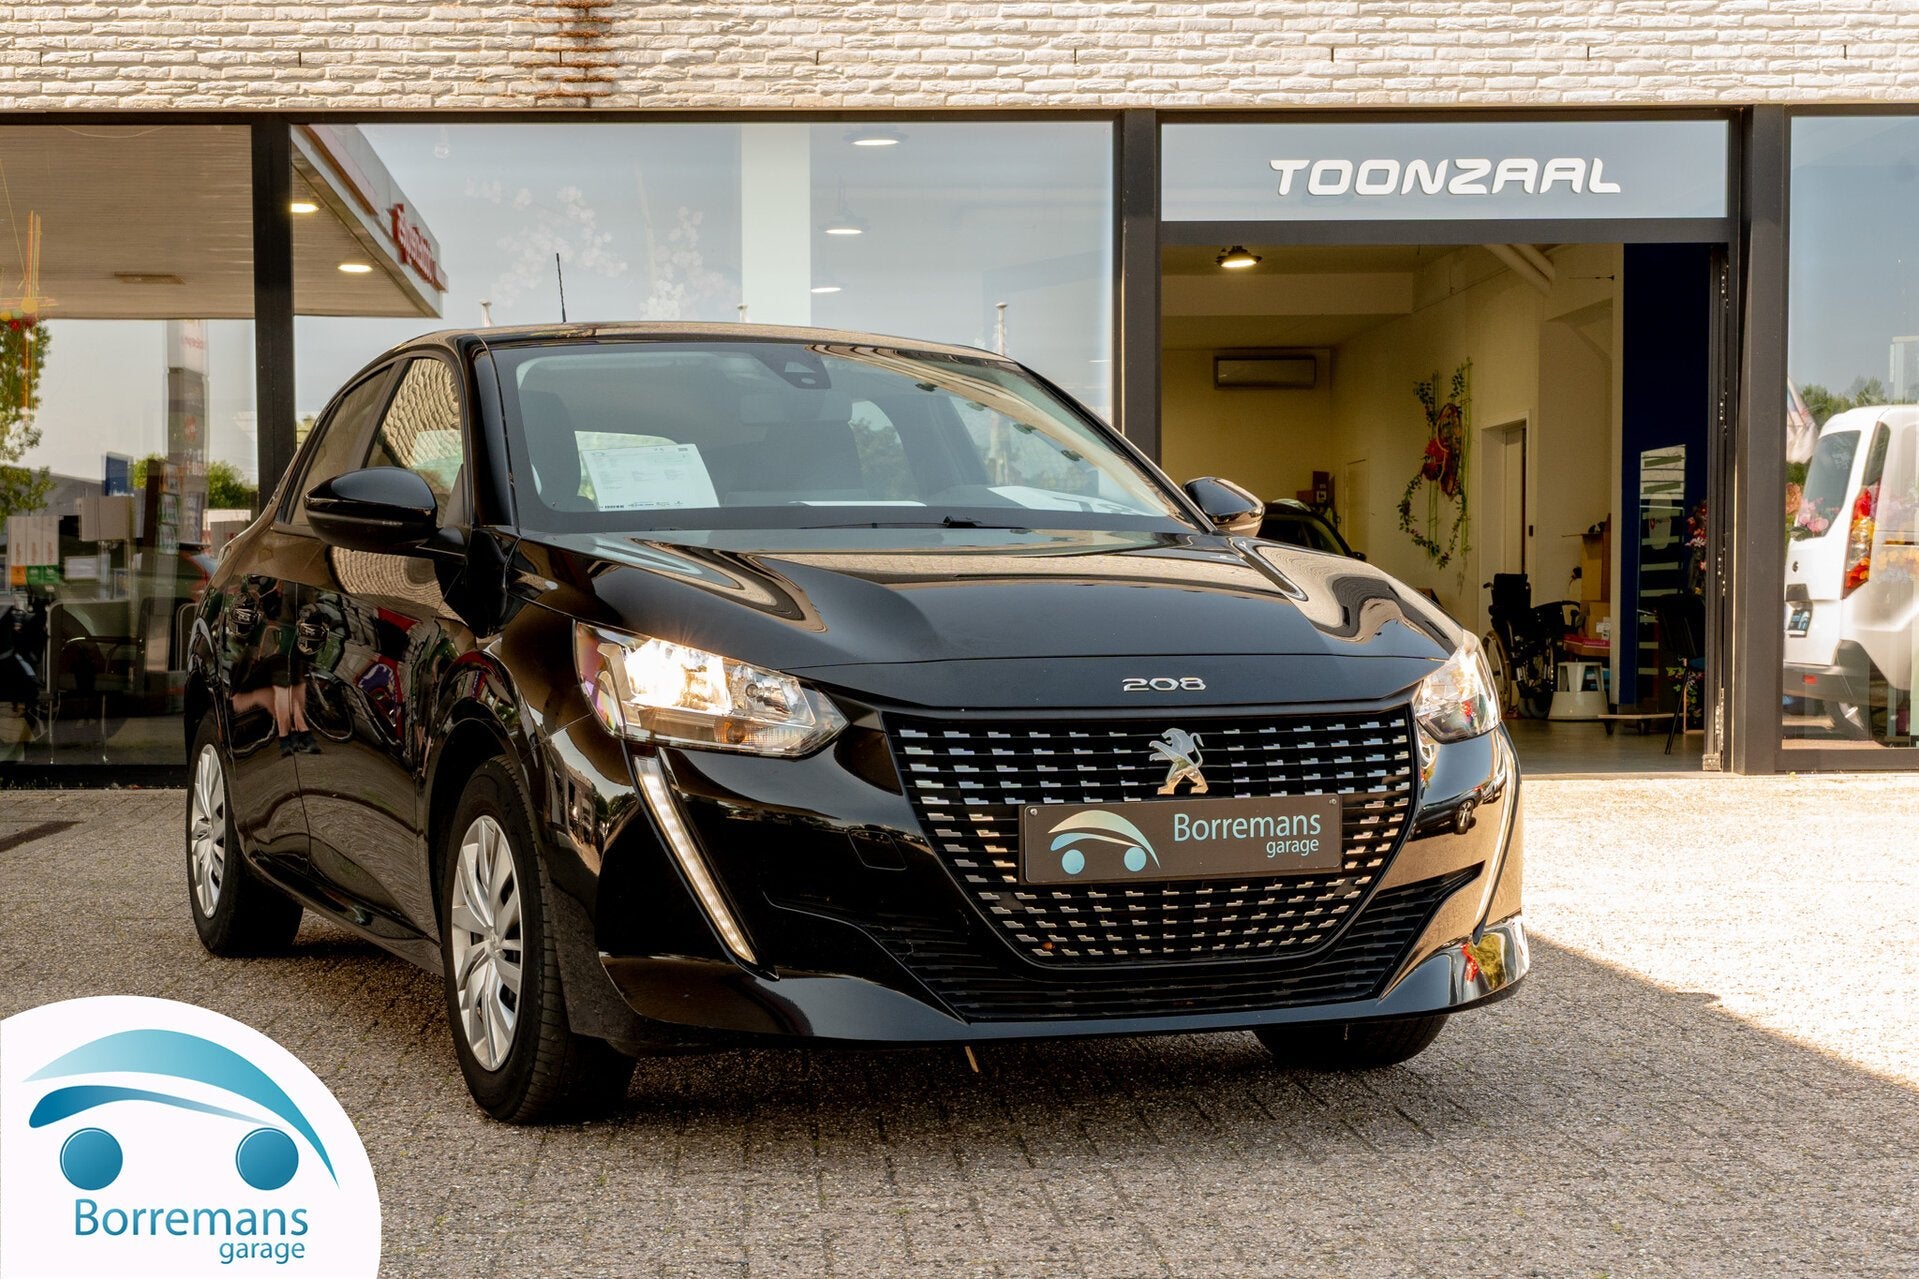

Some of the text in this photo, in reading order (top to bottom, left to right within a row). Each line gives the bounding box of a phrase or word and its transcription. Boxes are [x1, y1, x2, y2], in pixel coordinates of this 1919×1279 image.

[1270, 158, 1622, 196] TOONZAAL
[1121, 676, 1207, 692] 208
[1173, 812, 1322, 842] Borremans
[1265, 838, 1320, 859] garage
